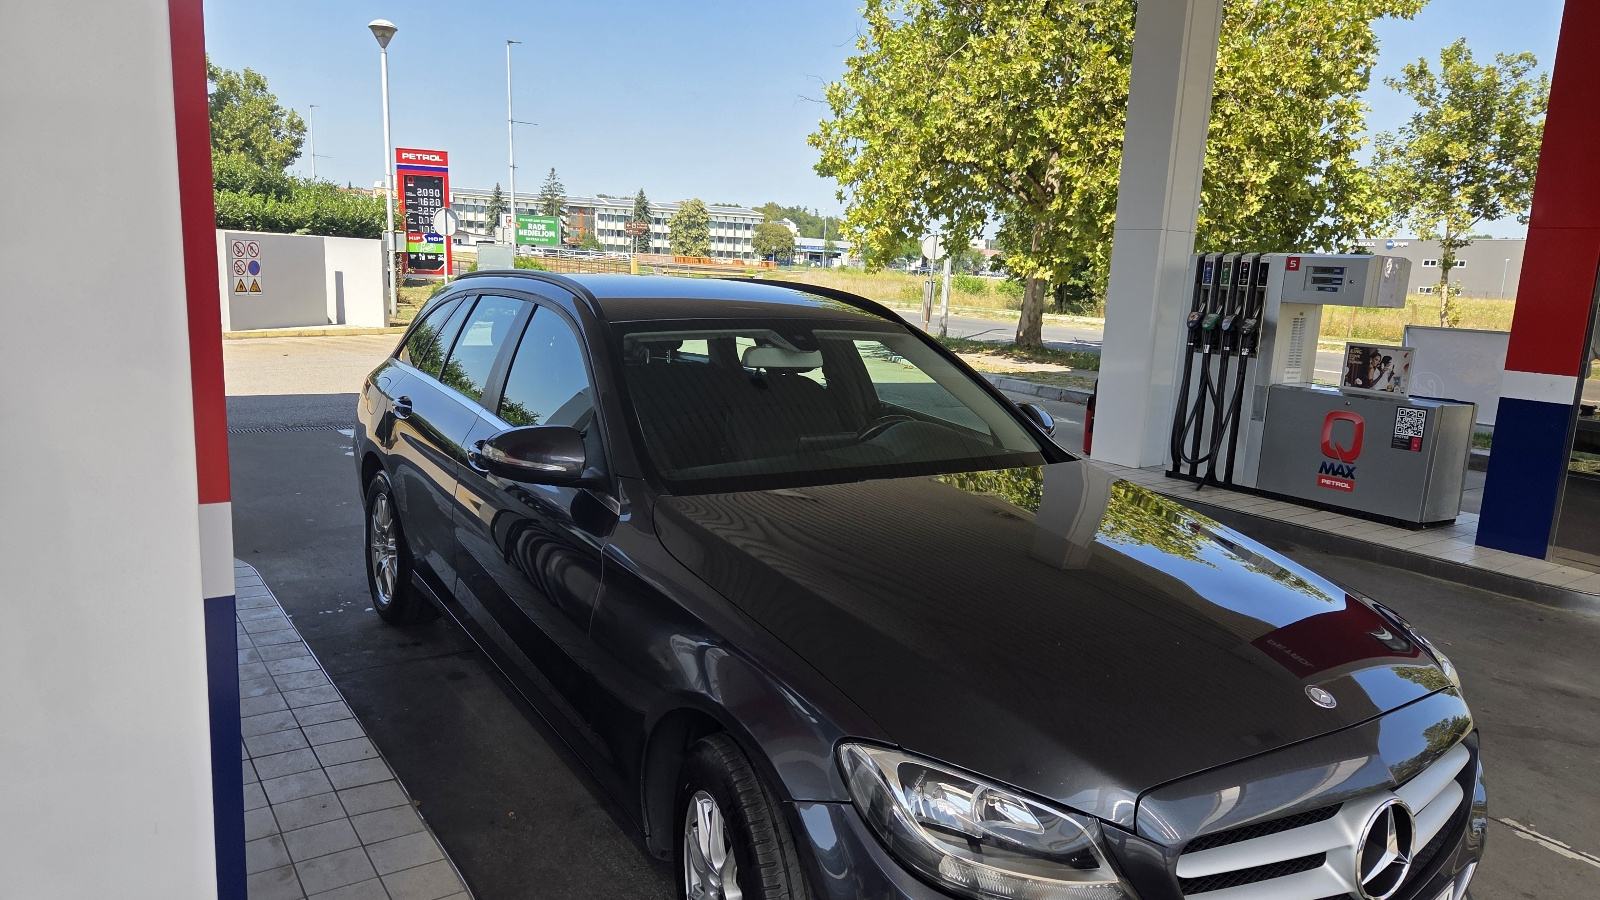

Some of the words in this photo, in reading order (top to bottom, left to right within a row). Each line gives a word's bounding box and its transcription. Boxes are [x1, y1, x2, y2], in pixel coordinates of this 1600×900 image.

[402, 152, 443, 162] PETROL
[527, 223, 547, 231] RADE
[1290, 260, 1297, 268] 5
[1320, 410, 1366, 464] Q
[1318, 461, 1357, 480] MAX
[1321, 478, 1351, 489] PETROL
